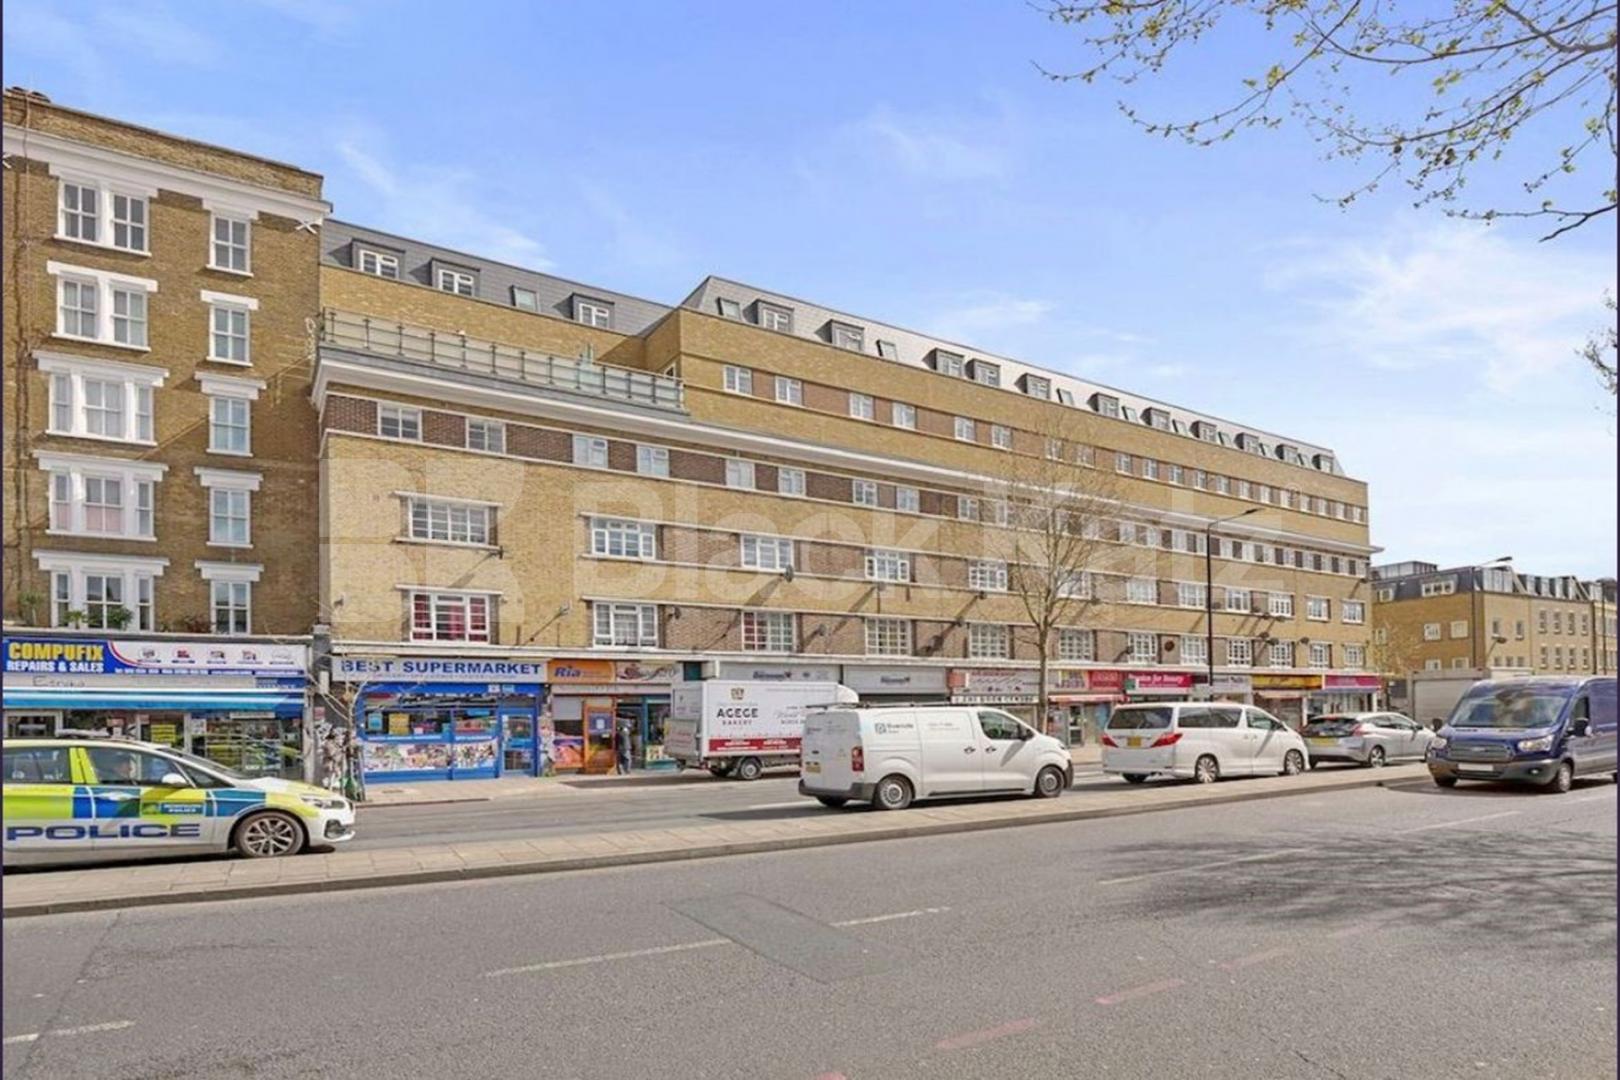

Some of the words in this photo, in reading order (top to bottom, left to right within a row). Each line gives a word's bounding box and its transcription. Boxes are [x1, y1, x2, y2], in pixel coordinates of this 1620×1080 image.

[8, 641, 104, 661] COMPUFIX
[6, 660, 55, 673] REPAIRS
[57, 661, 67, 673] &
[69, 662, 104, 673] SALES
[341, 660, 393, 672] BEST
[402, 661, 541, 675] SUPERMARKET
[554, 666, 581, 678] Ria
[6, 822, 200, 841] POLICE
